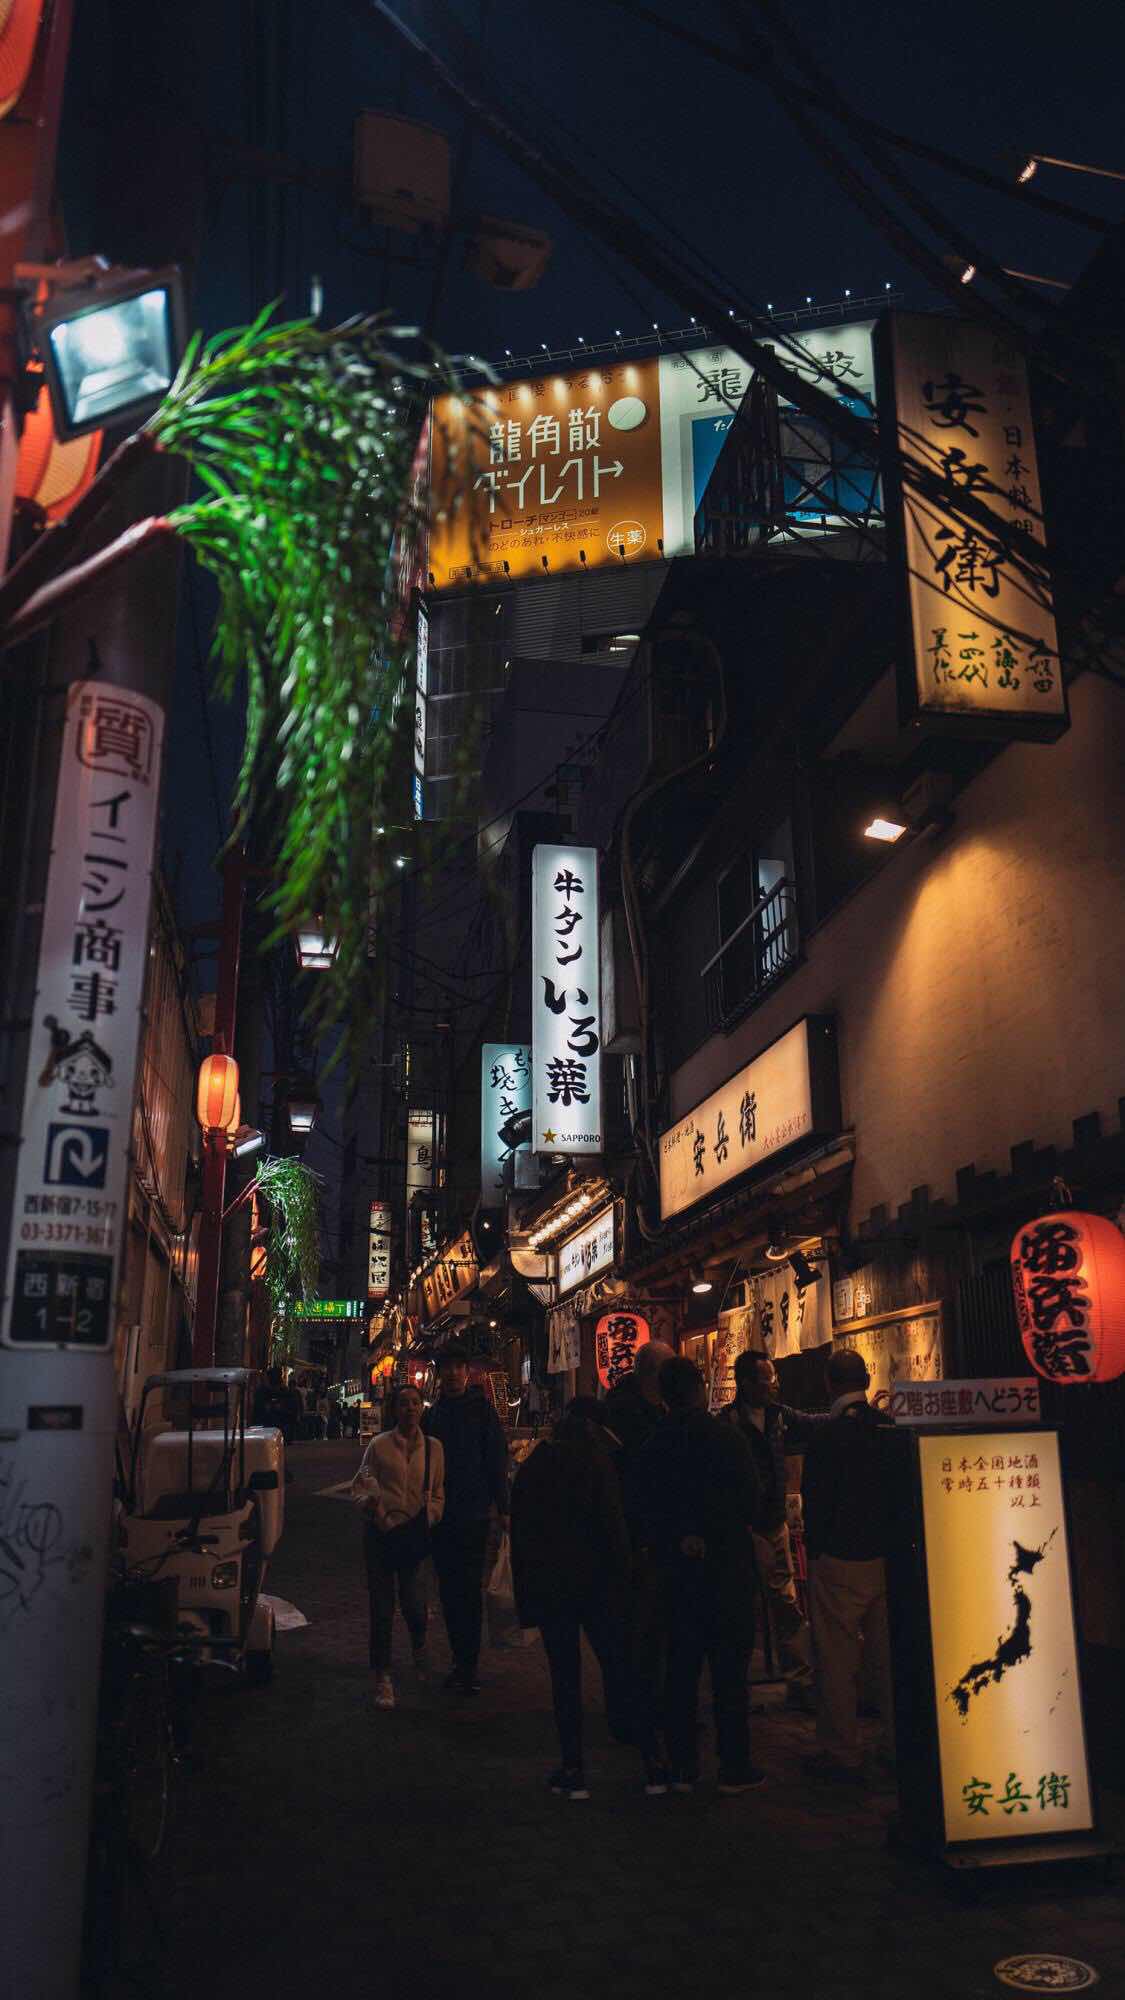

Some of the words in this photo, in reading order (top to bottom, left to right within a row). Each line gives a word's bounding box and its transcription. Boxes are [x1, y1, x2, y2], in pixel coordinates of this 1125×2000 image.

[489, 405, 602, 465] 龍角散
[472, 455, 625, 514] ダイレクト
[923, 372, 1002, 599] 安兵衛
[519, 522, 569, 536] シュガーレス
[609, 529, 642, 547] 生薬
[990, 632, 1022, 691] 八海山
[66, 790, 131, 1022] イニシ商事
[553, 868, 585, 966] 牛タン
[540, 975, 600, 1106] いろ葉
[560, 1133, 601, 1143] SAPPORO
[693, 1089, 758, 1177] 安兵衛
[941, 1473, 1041, 1493] 常時五十種類
[942, 1454, 1039, 1473] 日本全国地酒
[1010, 1494, 1041, 1508] 以上
[961, 1771, 1072, 1817] 安兵衛
